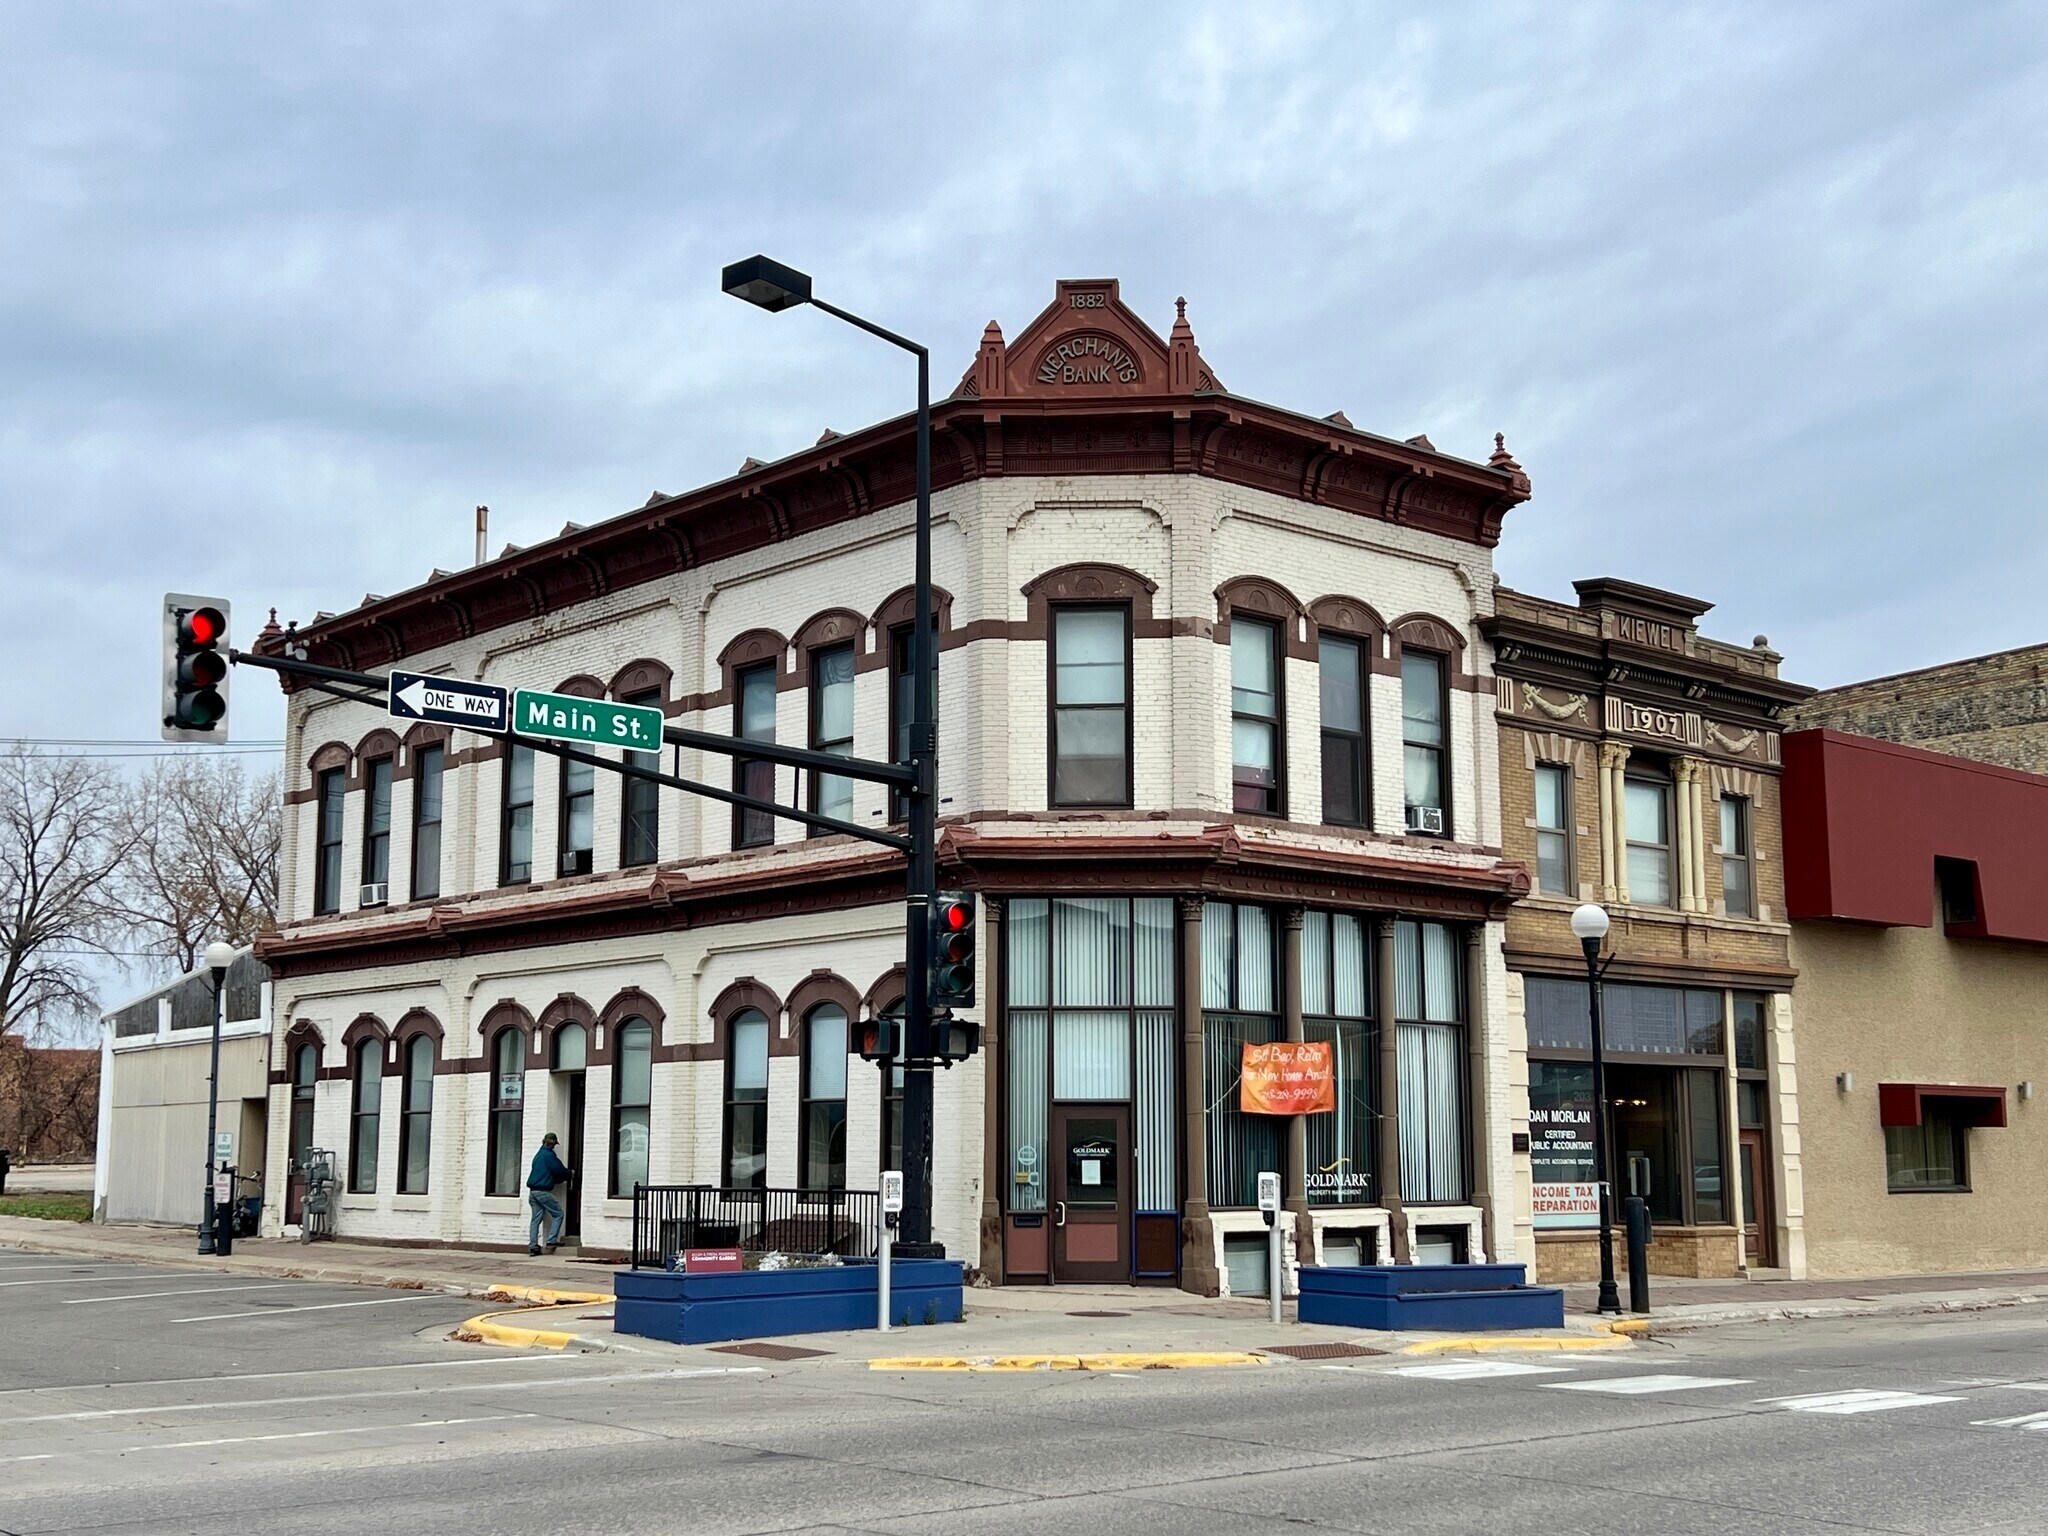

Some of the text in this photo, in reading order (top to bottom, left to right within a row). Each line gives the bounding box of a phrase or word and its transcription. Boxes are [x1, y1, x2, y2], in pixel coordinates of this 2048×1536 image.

[1070, 294, 1105, 308] 1882
[1037, 337, 1138, 384] MERCHANTS
[1063, 365, 1112, 383] BANK
[1620, 615, 1680, 651] KIEWEL
[424, 691, 495, 714] ONE WAY
[528, 701, 649, 741] Main St.
[1631, 709, 1678, 734] 1907
[1573, 1090, 1591, 1102] 203
[1529, 1109, 1591, 1123] DAN MORLAN
[1544, 1129, 1577, 1139] CERTIFIED
[1530, 1141, 1550, 1150] UBLIC
[1552, 1141, 1593, 1150] ACCOUNTANT
[1304, 1173, 1368, 1187] GOLDMARK
[1533, 1186, 1593, 1198] NCOME TAX
[1533, 1200, 1598, 1211] REPARATION
